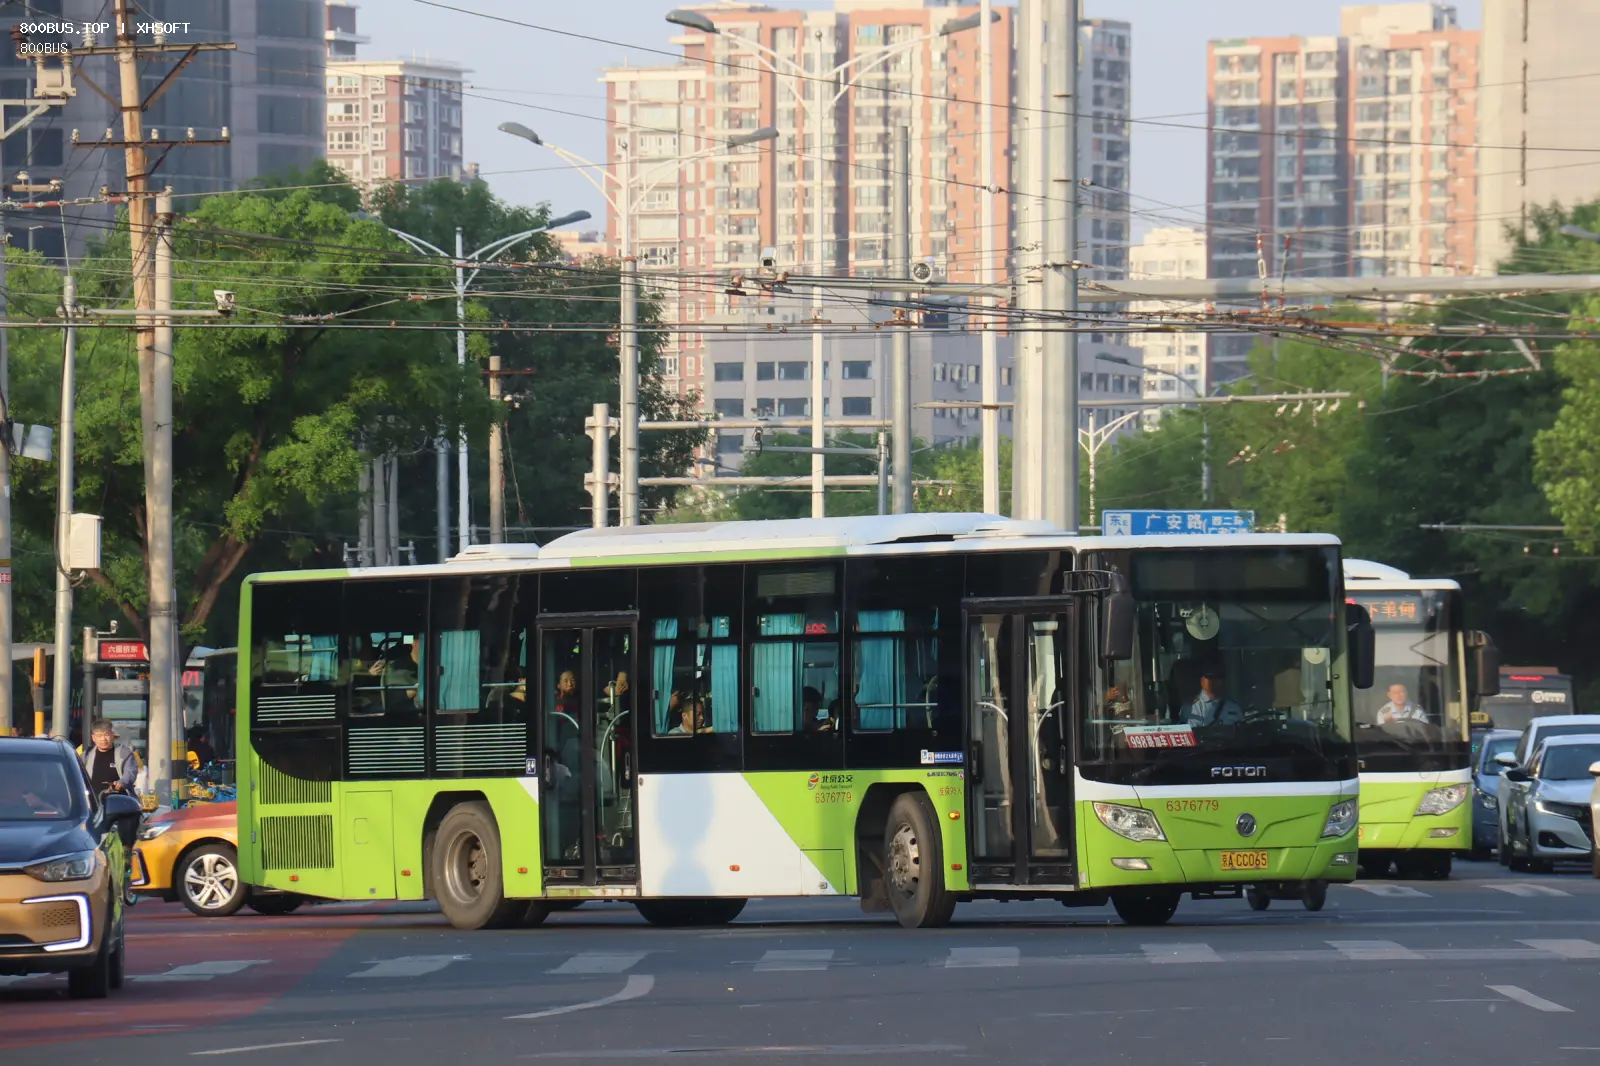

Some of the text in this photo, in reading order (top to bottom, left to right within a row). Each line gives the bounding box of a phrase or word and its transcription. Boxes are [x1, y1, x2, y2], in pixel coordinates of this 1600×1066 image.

[1145, 514, 1202, 530] 广安路
[1211, 766, 1267, 778] FOTON
[815, 792, 852, 803] 6376779
[1166, 799, 1219, 812] 6376779
